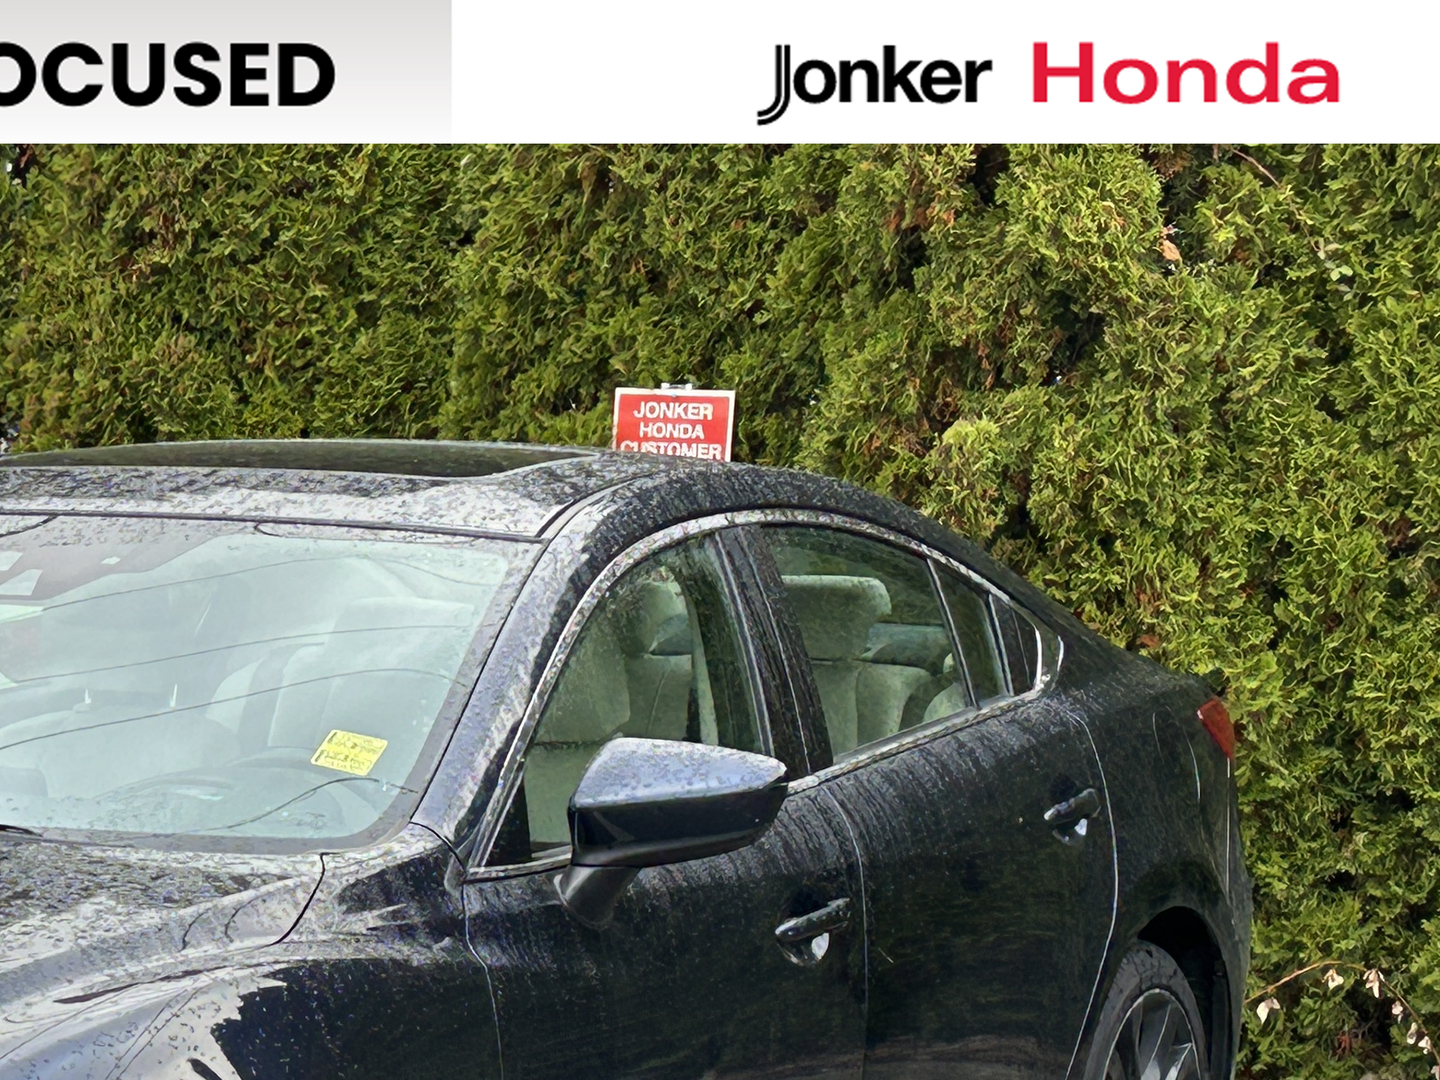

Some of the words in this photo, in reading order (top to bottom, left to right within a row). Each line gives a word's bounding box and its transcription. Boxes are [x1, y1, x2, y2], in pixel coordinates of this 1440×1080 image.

[633, 401, 713, 420] JONKER
[639, 421, 705, 439] HONDA
[620, 440, 722, 460] CUSTOMER
